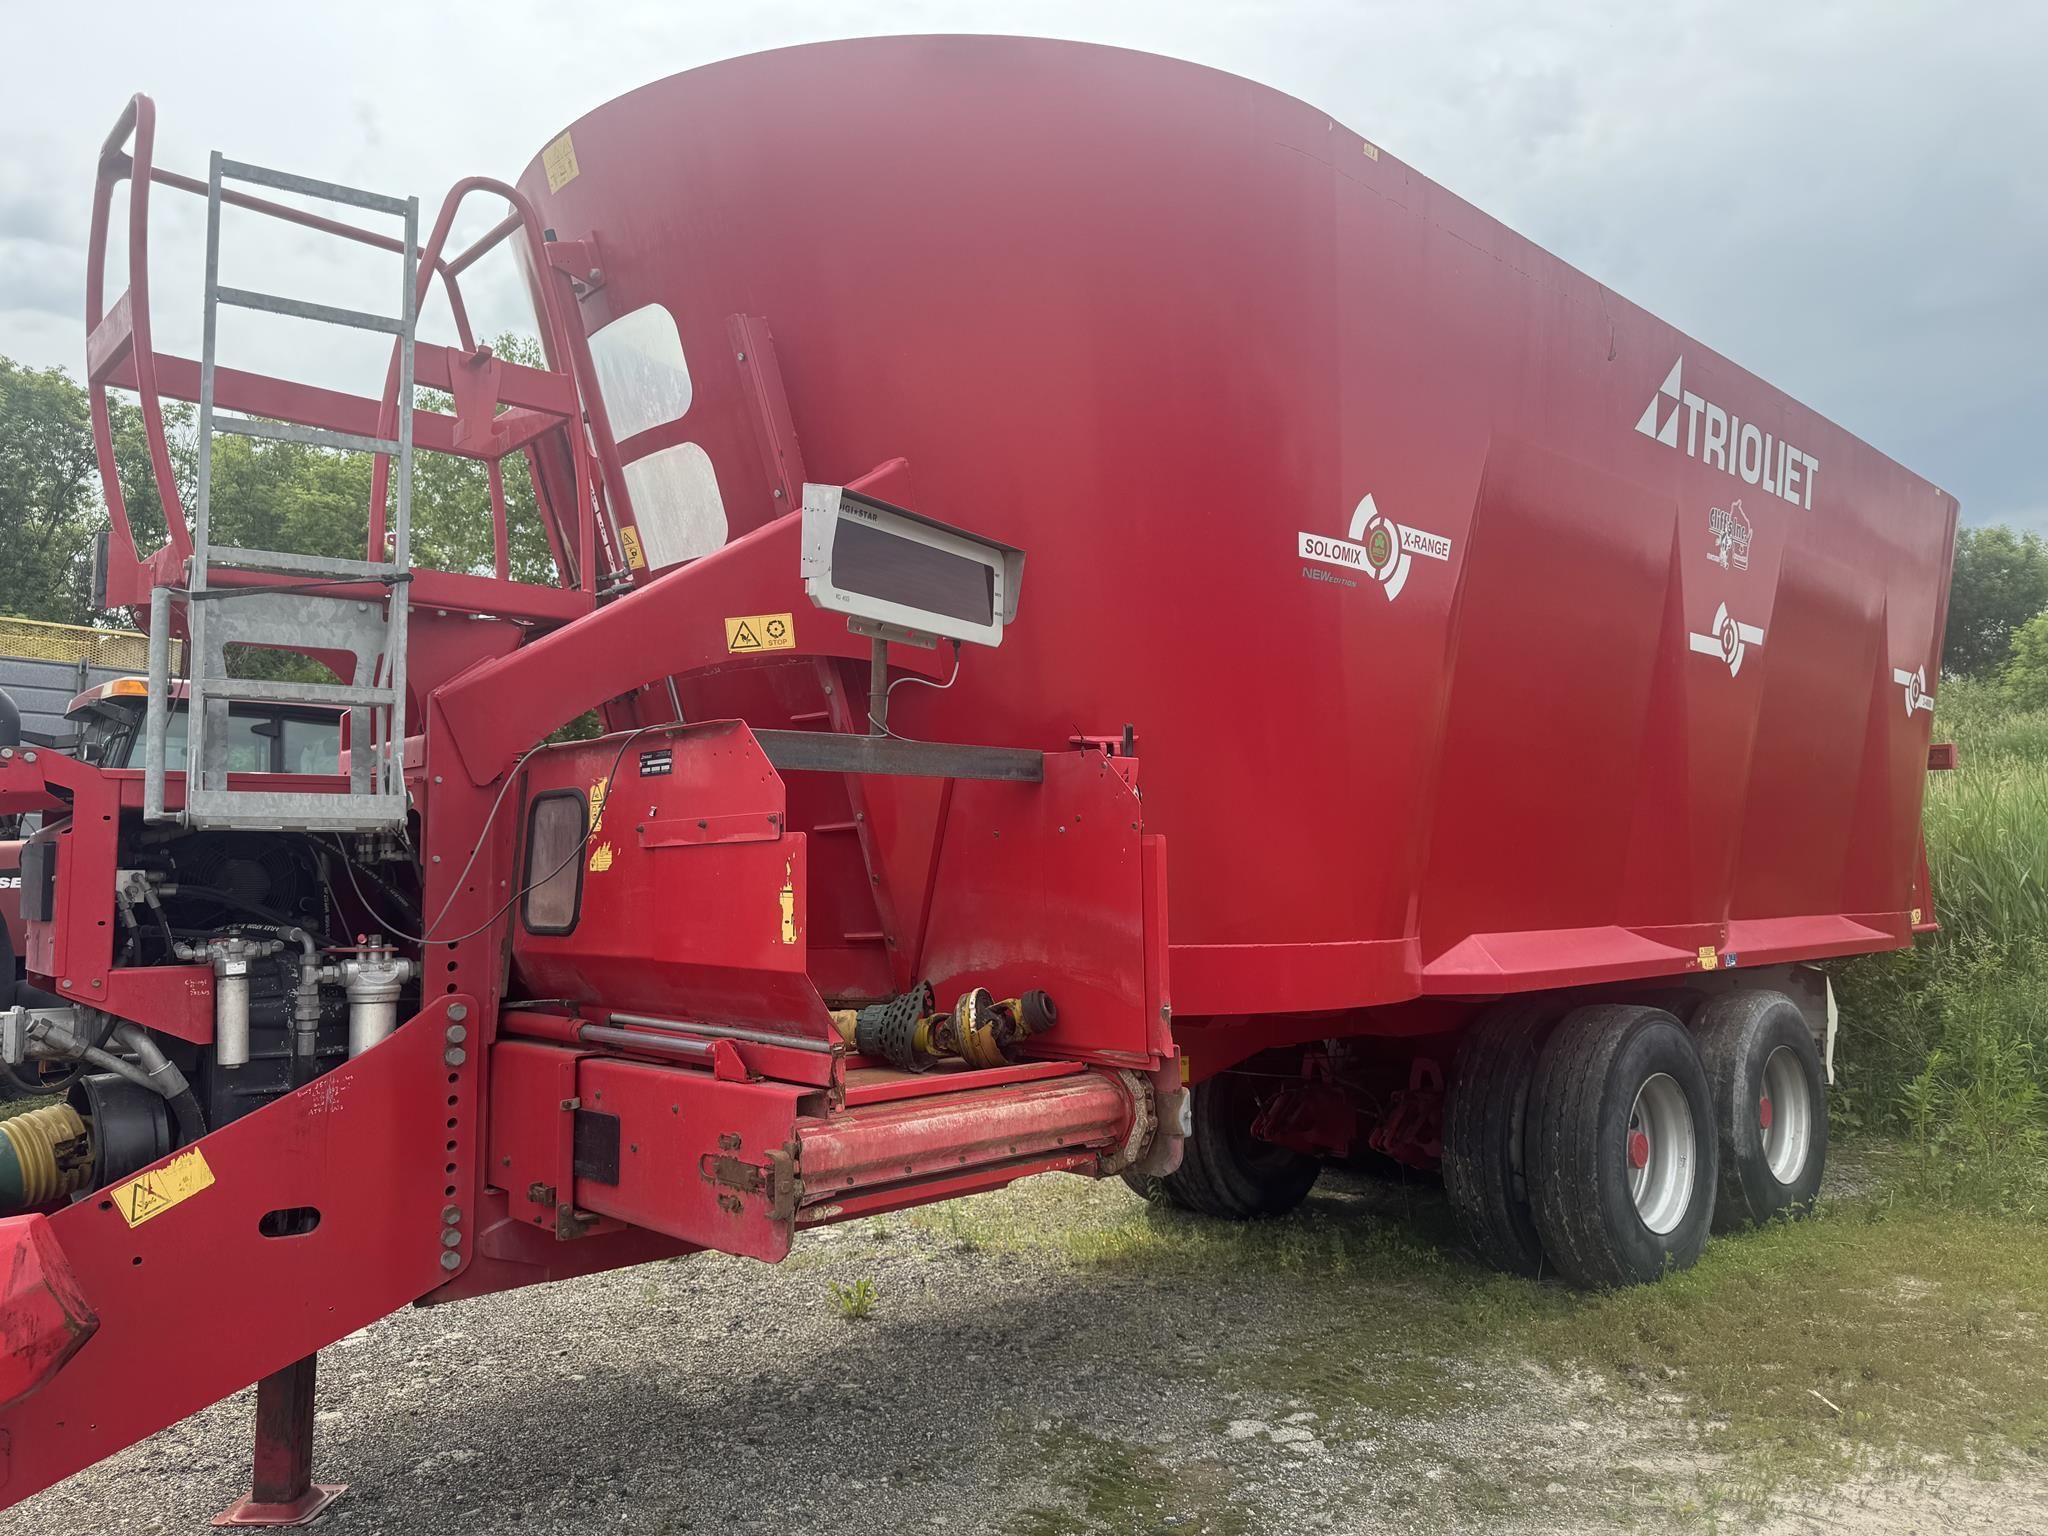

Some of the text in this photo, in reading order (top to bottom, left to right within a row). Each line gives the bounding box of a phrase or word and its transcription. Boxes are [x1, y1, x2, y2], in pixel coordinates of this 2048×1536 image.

[1684, 390, 1819, 510] TRIOLIET
[1305, 538, 1361, 566] SOLOMIX
[1403, 531, 1449, 557] X-RANGE
[768, 639, 788, 647] STOP
